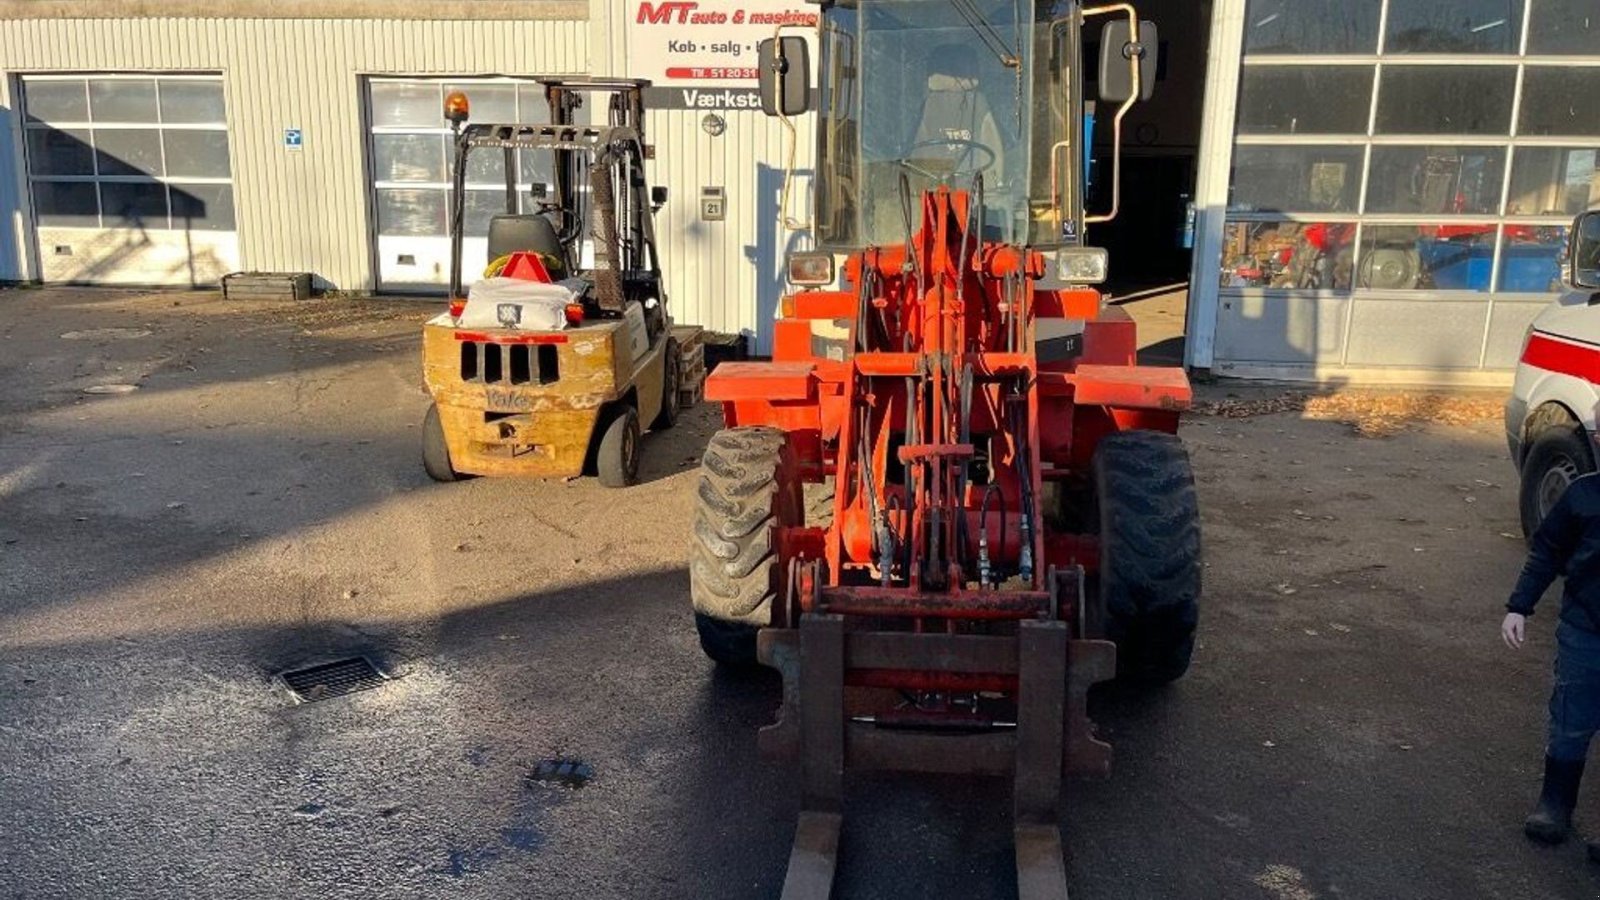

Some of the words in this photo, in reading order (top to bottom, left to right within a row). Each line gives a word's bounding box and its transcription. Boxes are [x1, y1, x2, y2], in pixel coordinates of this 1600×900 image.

[732, 9, 745, 25] &
[668, 40, 697, 53] Køb
[710, 40, 741, 56] salg
[711, 68, 724, 78] 51
[726, 68, 741, 78] 20
[742, 68, 756, 78] 31
[707, 203, 719, 214] 21
